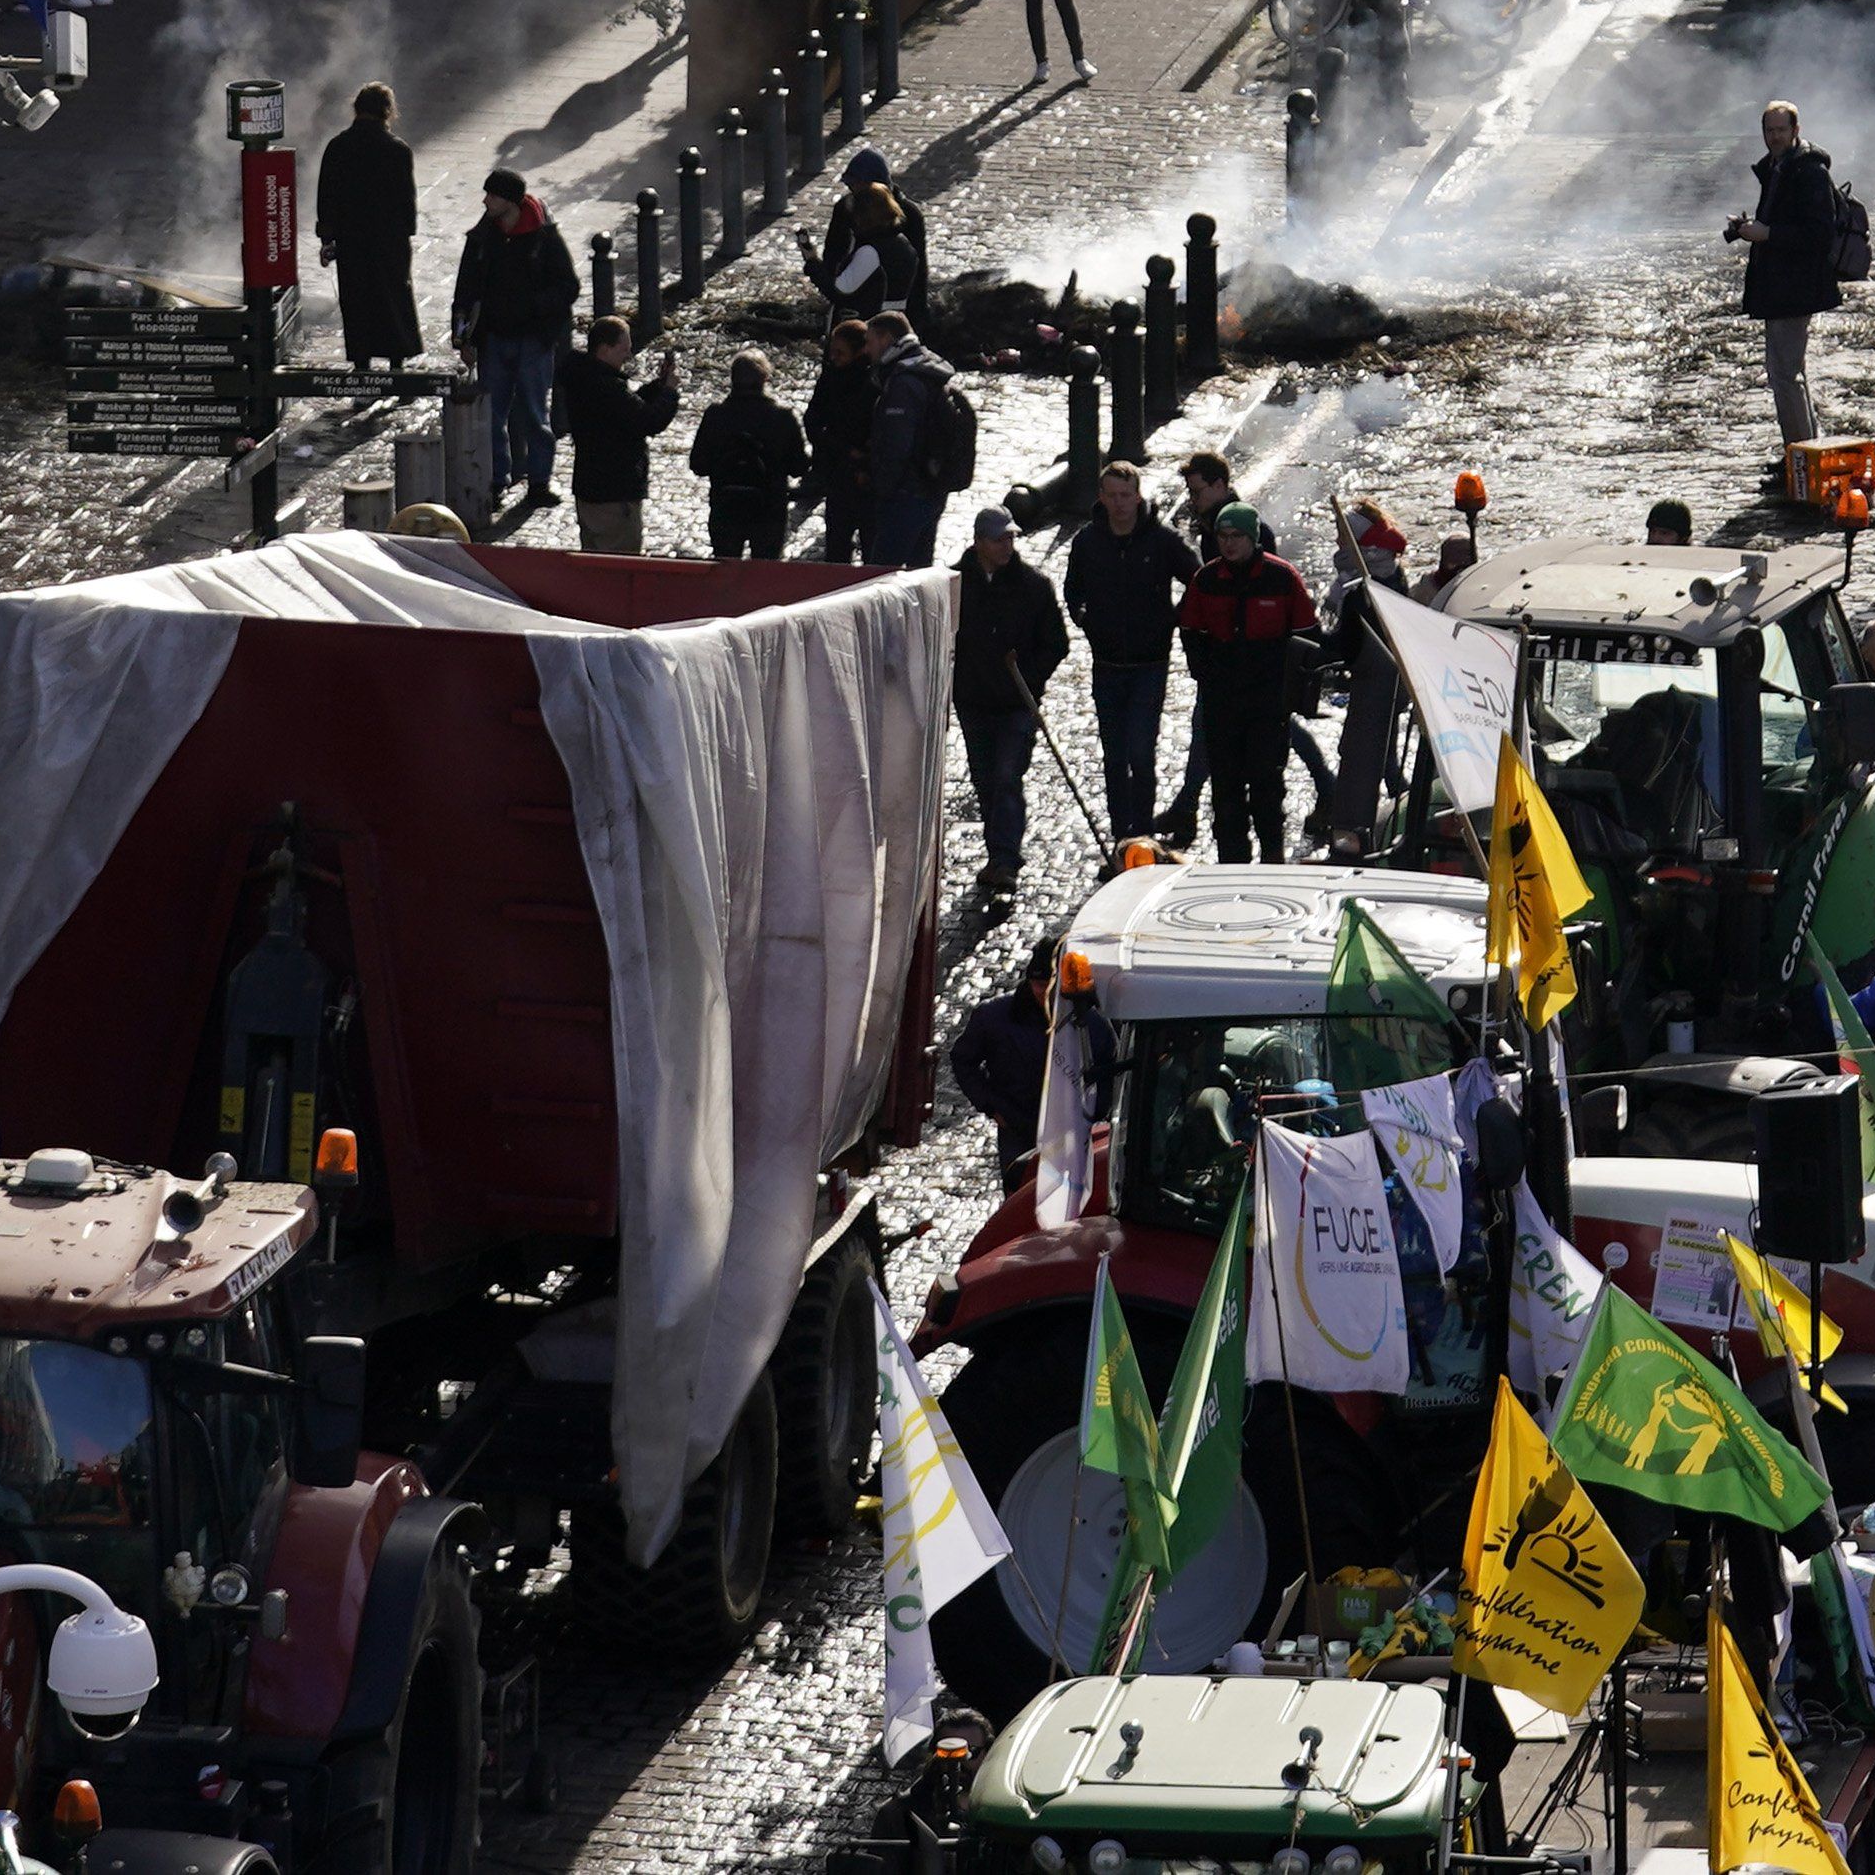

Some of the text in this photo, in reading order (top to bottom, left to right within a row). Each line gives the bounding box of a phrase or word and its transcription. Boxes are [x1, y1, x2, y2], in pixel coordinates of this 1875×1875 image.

[267, 220, 278, 263] Quartier
[131, 312, 199, 324] Parc Léopold
[102, 341, 130, 351] Maison
[132, 342, 143, 351] de
[132, 352, 143, 361] de
[313, 376, 341, 385] Place
[345, 376, 360, 385] du
[325, 386, 382, 397] Troonplein
[135, 403, 150, 412] des
[153, 403, 190, 413] Sciences
[193, 404, 237, 414] Naturelles
[129, 413, 148, 422] voor
[115, 433, 167, 443] Parlement
[116, 443, 220, 454] Europees Parlement
[1781, 879, 1817, 982] Cornil
[1670, 1219, 1699, 1230] STOP
[1313, 1207, 1392, 1255] FUGEA
[1573, 1344, 1623, 1422] EUROPEAN
